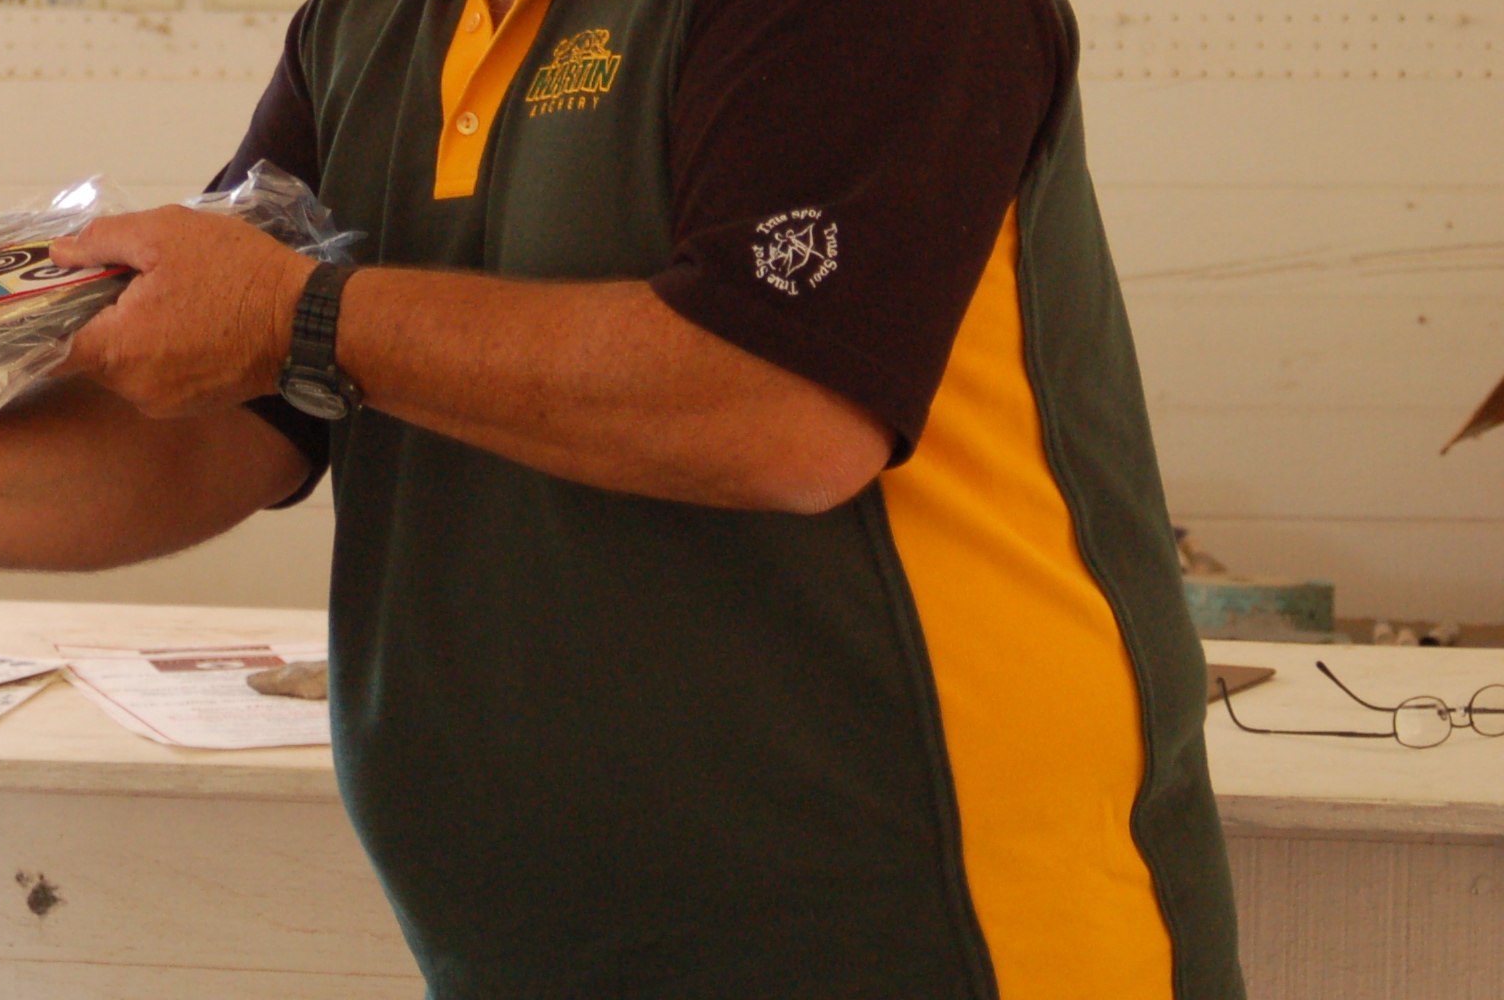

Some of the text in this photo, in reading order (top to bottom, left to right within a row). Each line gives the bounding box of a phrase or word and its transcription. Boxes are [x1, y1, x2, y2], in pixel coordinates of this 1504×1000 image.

[525, 54, 622, 102] MARTIN
[823, 222, 838, 258] True
[767, 274, 800, 295] True
